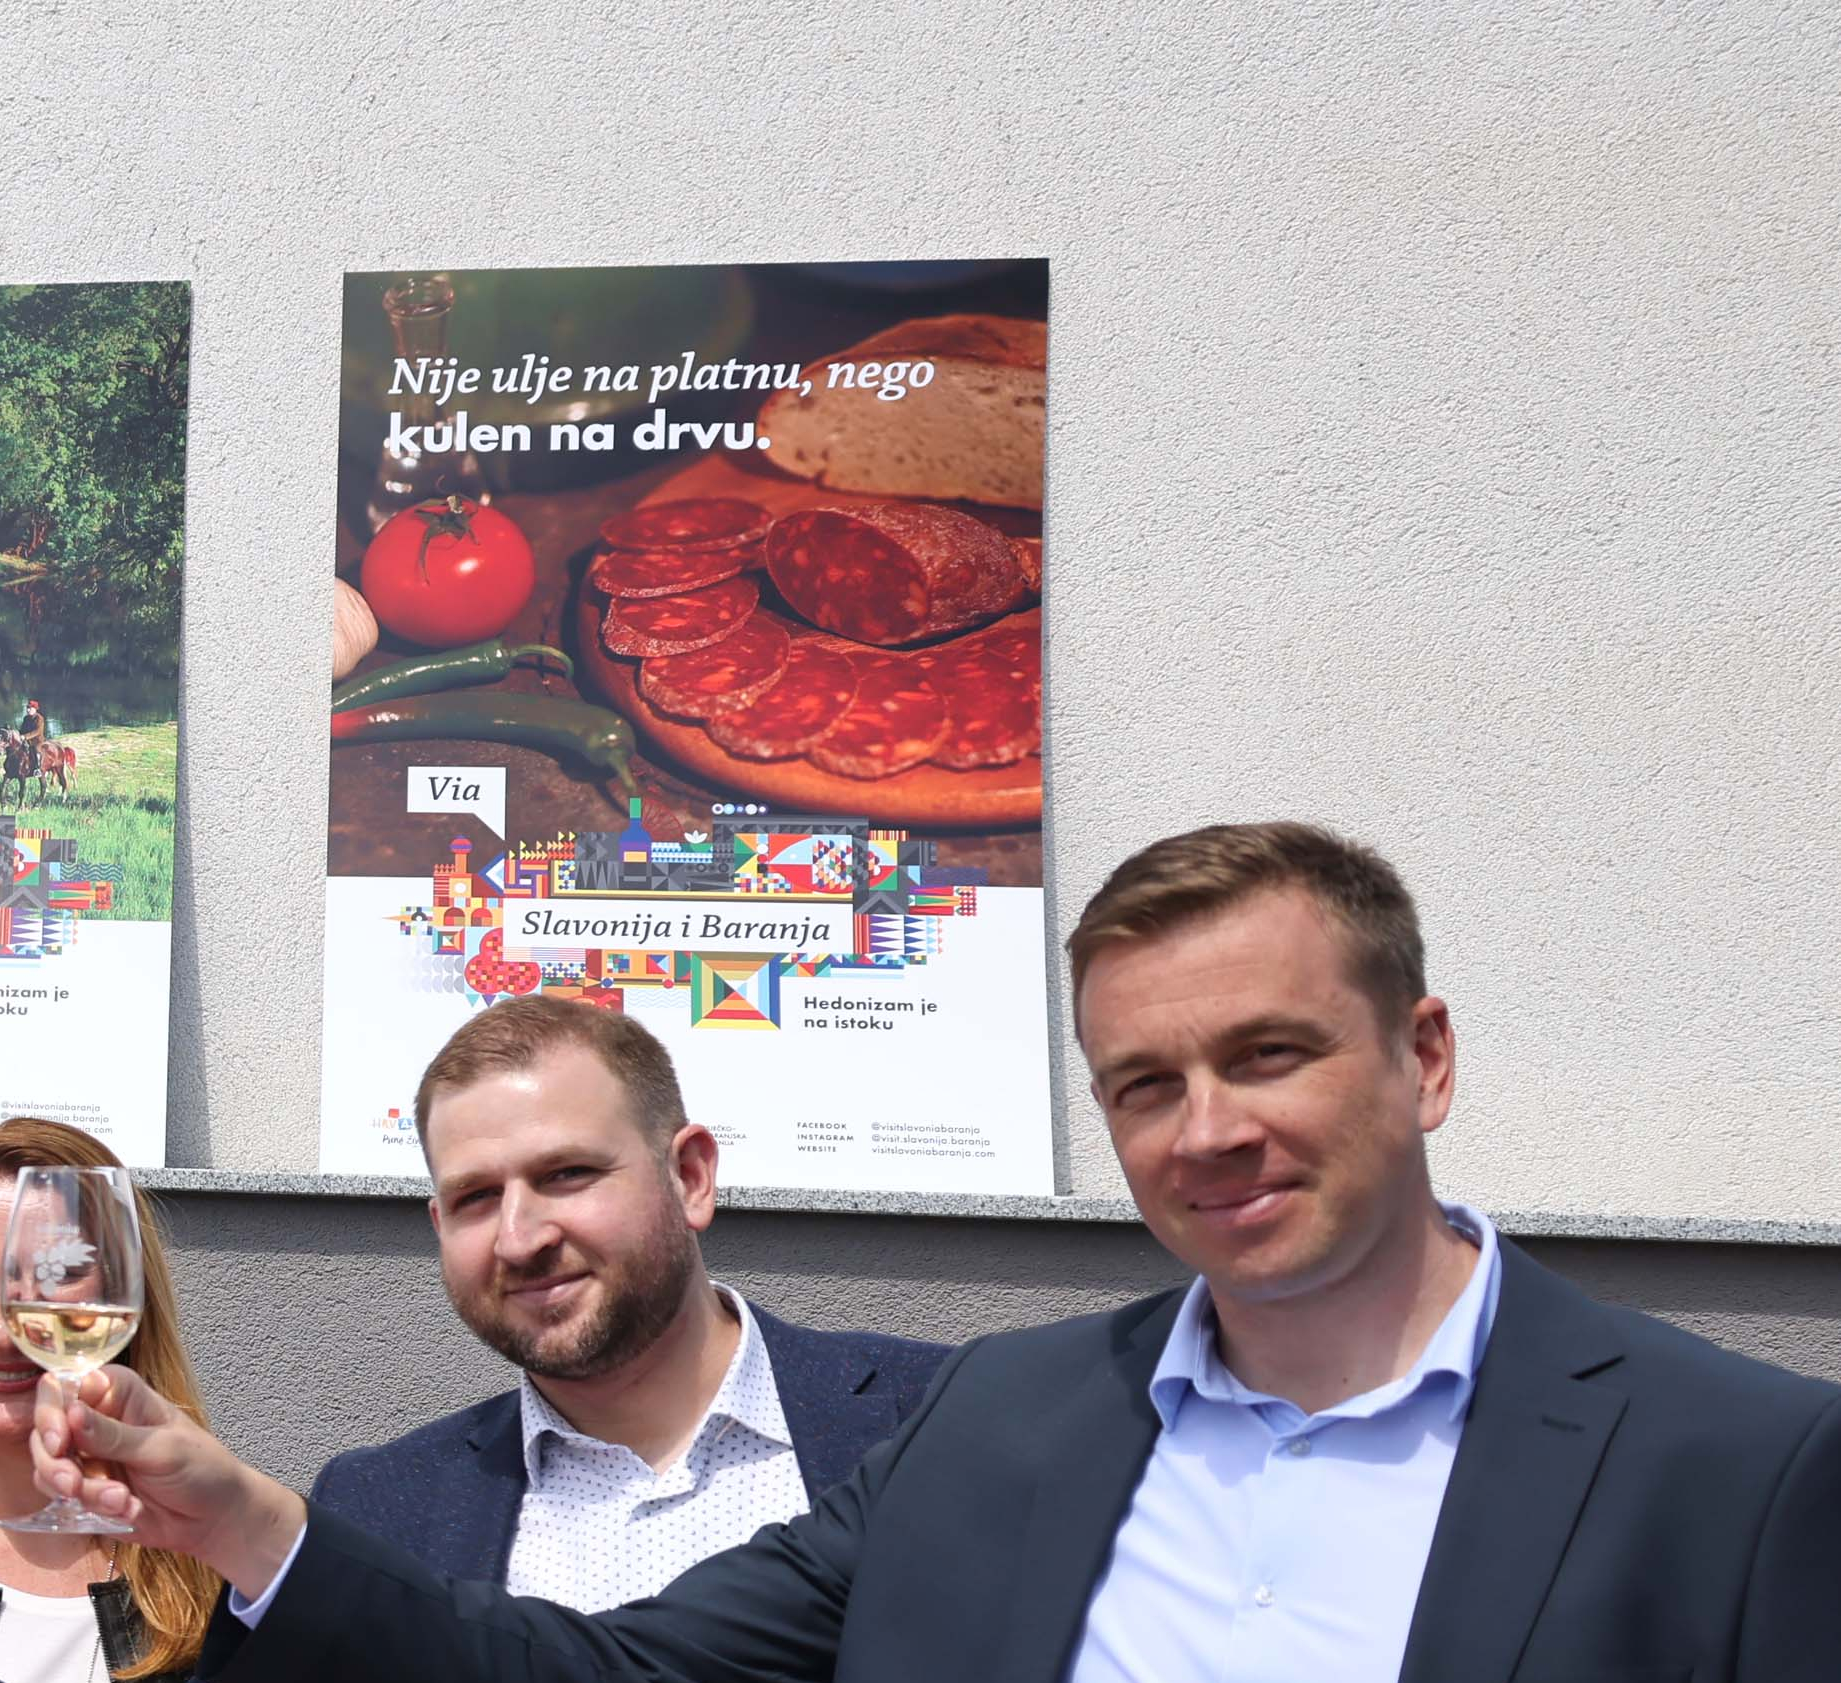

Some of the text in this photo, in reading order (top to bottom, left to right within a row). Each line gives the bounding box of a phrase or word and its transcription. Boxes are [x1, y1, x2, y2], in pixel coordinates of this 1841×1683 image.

[388, 351, 935, 404] Nije ulje na platnu, nego
[389, 409, 771, 453] kulen na drvu.
[428, 776, 481, 802] Via
[522, 910, 831, 947] Slavonija i Baranja
[54, 986, 69, 1003] je
[804, 997, 938, 1016] Hedonizam je
[804, 1014, 894, 1030] na istoku
[797, 1122, 980, 1135] FACEBOOK @visitslavoniabaranja
